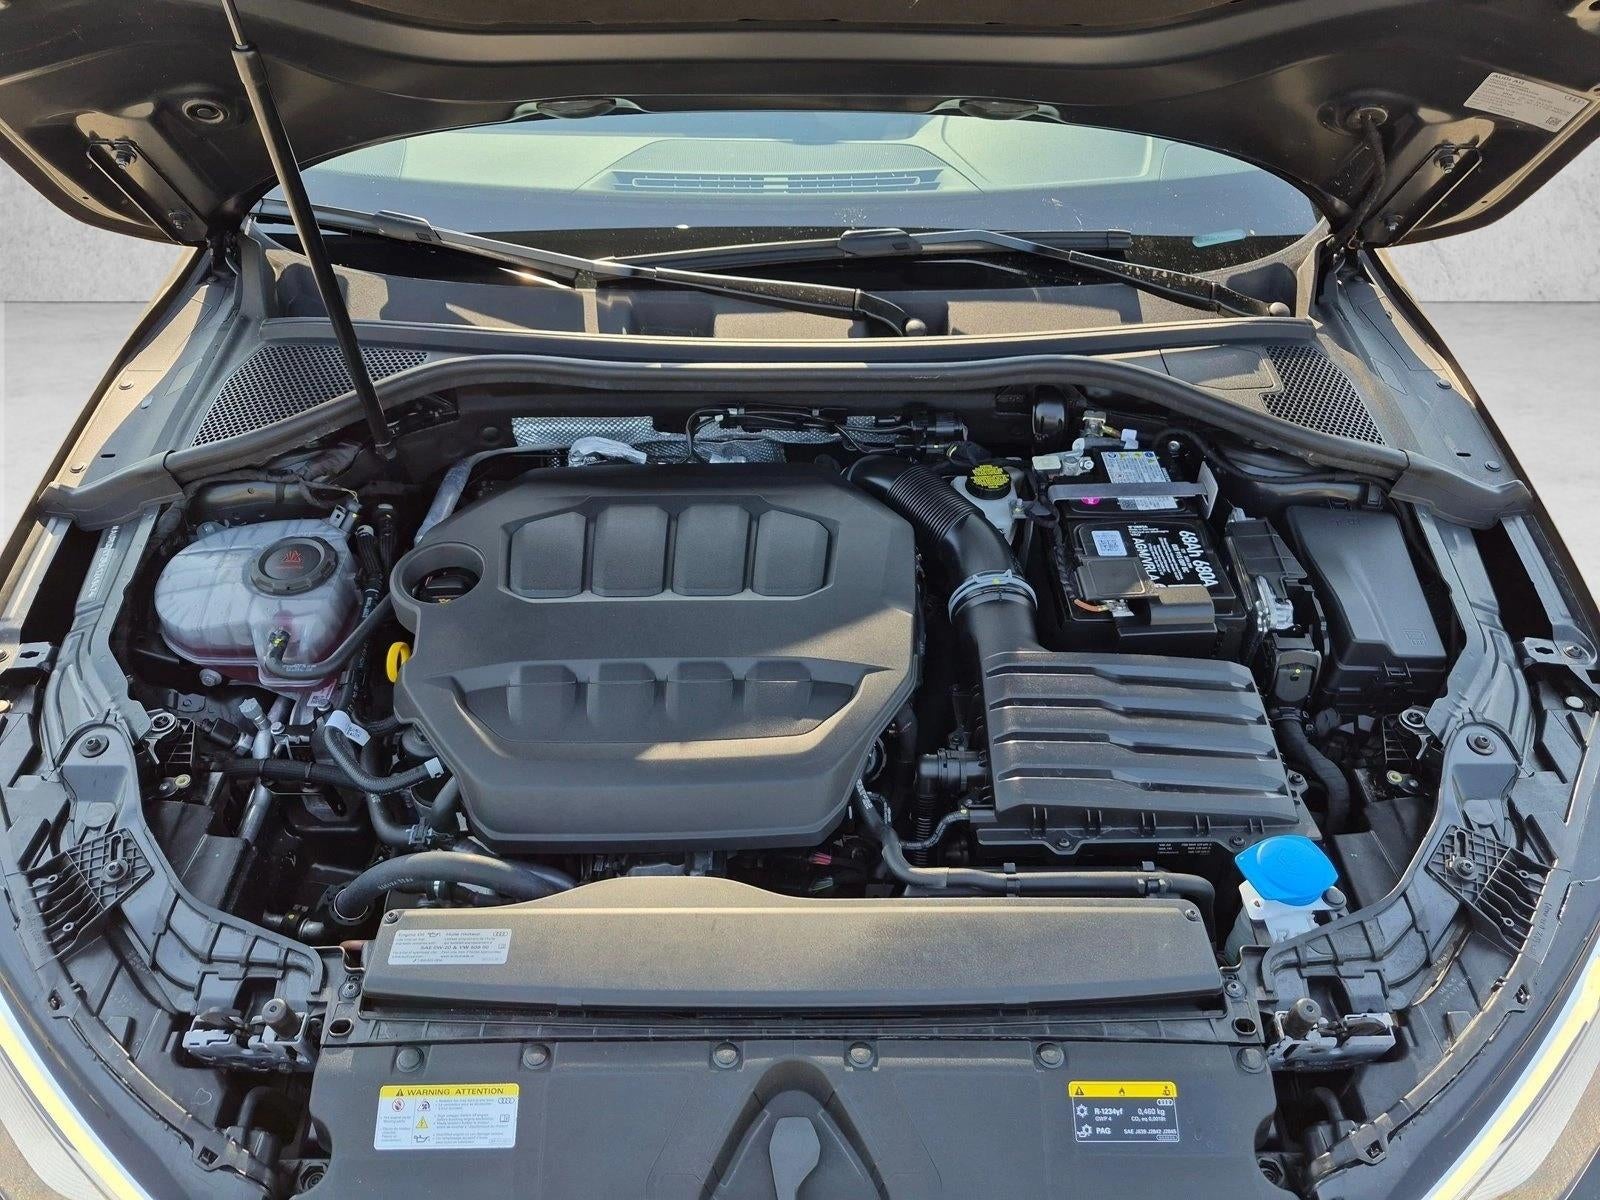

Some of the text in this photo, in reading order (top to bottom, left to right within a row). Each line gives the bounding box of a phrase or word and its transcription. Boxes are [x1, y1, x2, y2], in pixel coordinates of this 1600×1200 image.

[1131, 538, 1160, 580] AGM/VRLA
[1178, 530, 1219, 587] 68Ah 680A
[407, 1087, 504, 1096] WARNING ATTENTION
[1094, 1107, 1123, 1116] R-1234yf
[1157, 1107, 1166, 1117] kg
[1096, 1127, 1112, 1135] PAG
